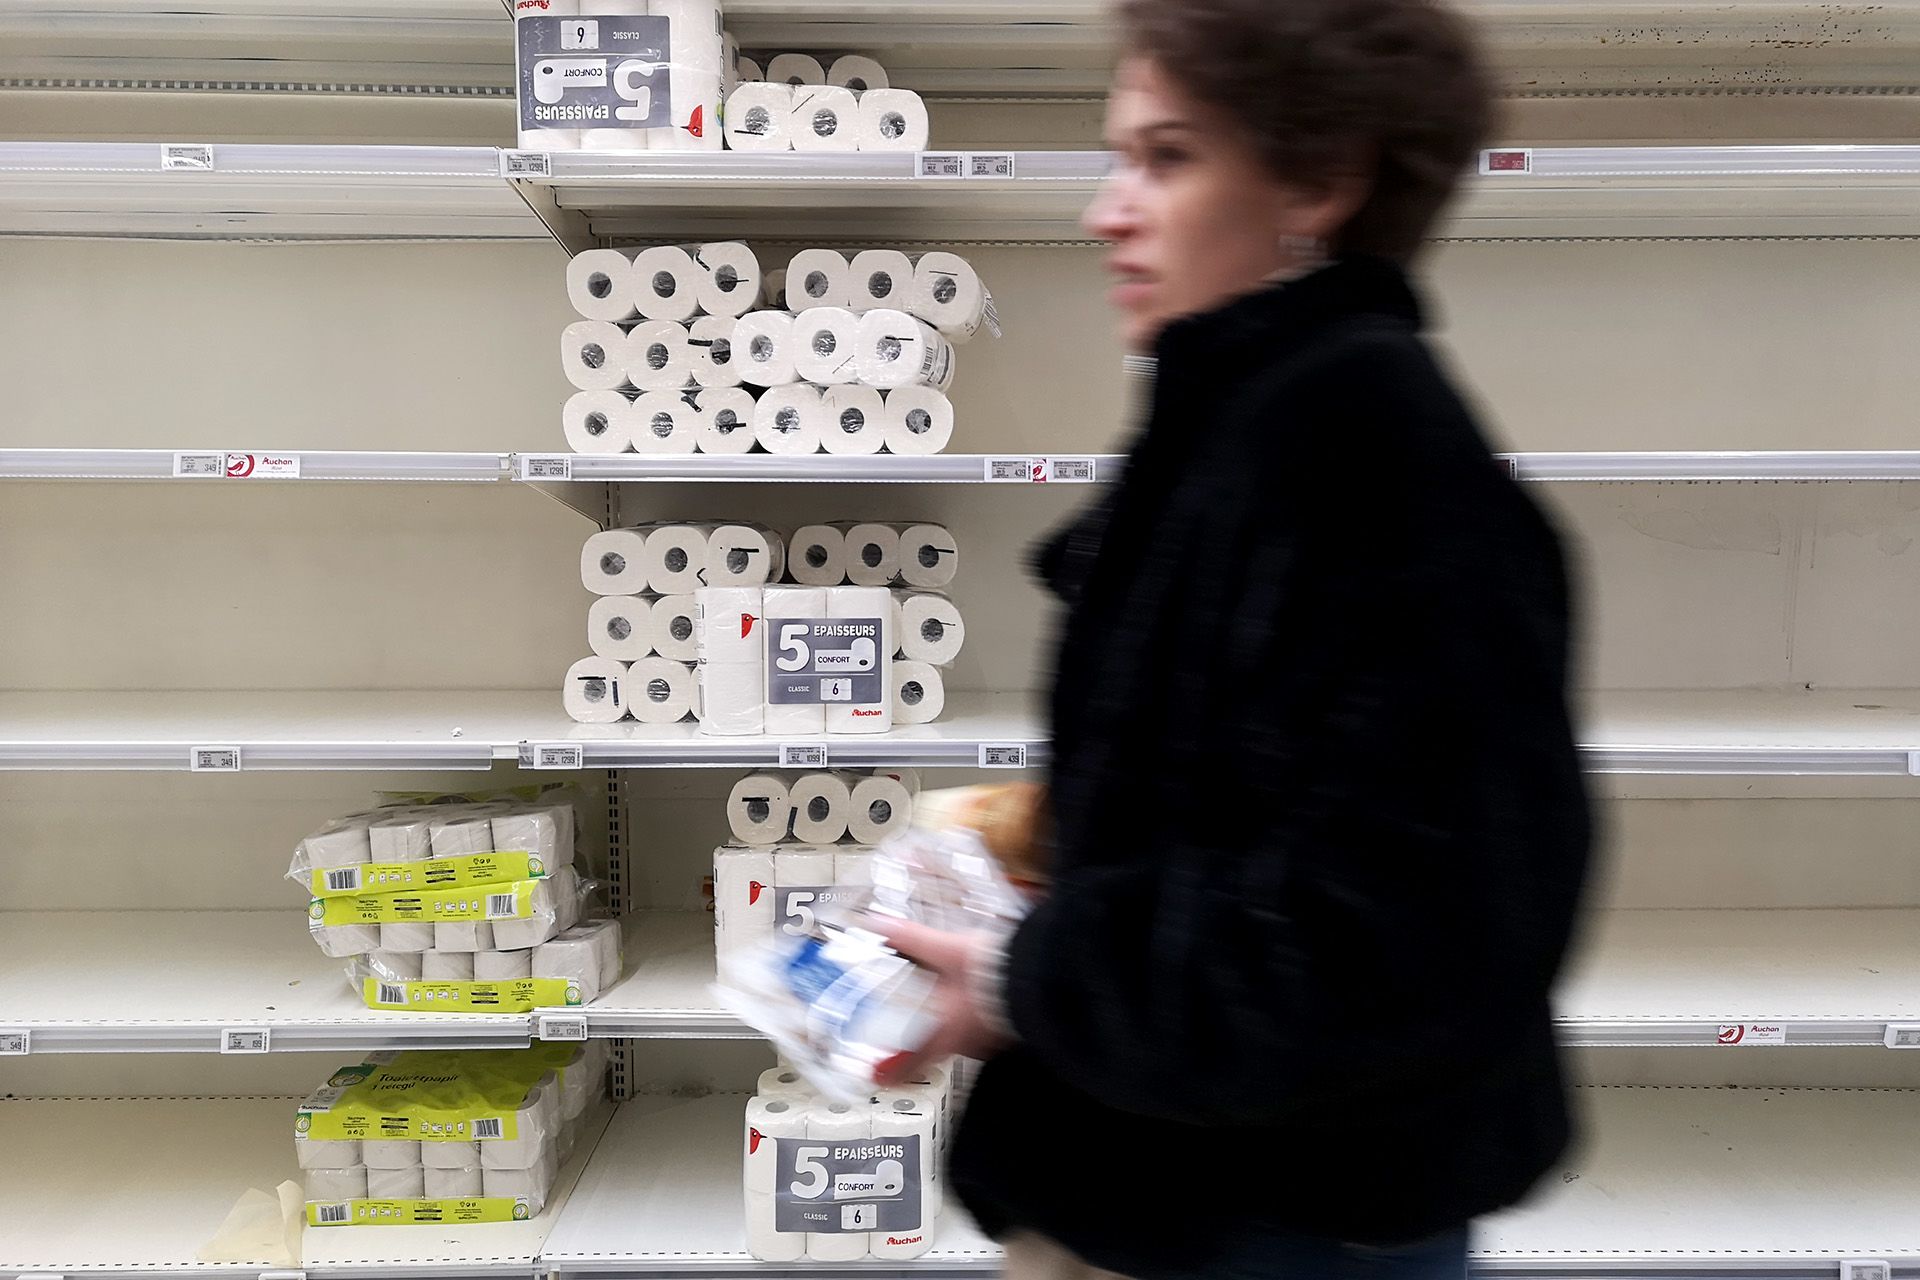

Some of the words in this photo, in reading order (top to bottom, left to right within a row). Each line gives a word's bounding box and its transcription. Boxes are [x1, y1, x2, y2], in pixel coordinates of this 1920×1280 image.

[577, 27, 585, 44] 6
[612, 31, 640, 40] CLASSIC
[564, 68, 603, 77] CONFORT
[613, 58, 654, 120] 5
[535, 105, 609, 120] EPAISSEURS
[262, 456, 293, 466] Auchan
[549, 466, 564, 475] 1299
[813, 624, 876, 637] EPAISSEURS
[776, 624, 810, 672] 5
[817, 656, 850, 664] CONFORT
[832, 682, 839, 695] 6
[851, 708, 883, 717] Auchan
[782, 891, 815, 937] 5
[1750, 1025, 1780, 1033] Auchan
[834, 1144, 904, 1161] EPAISSEURS
[789, 1146, 829, 1199] 5
[837, 1182, 875, 1192] CONFORT
[803, 1212, 828, 1221] CLASSIC
[854, 1209, 862, 1224] 6
[886, 1235, 922, 1246] Auchan
